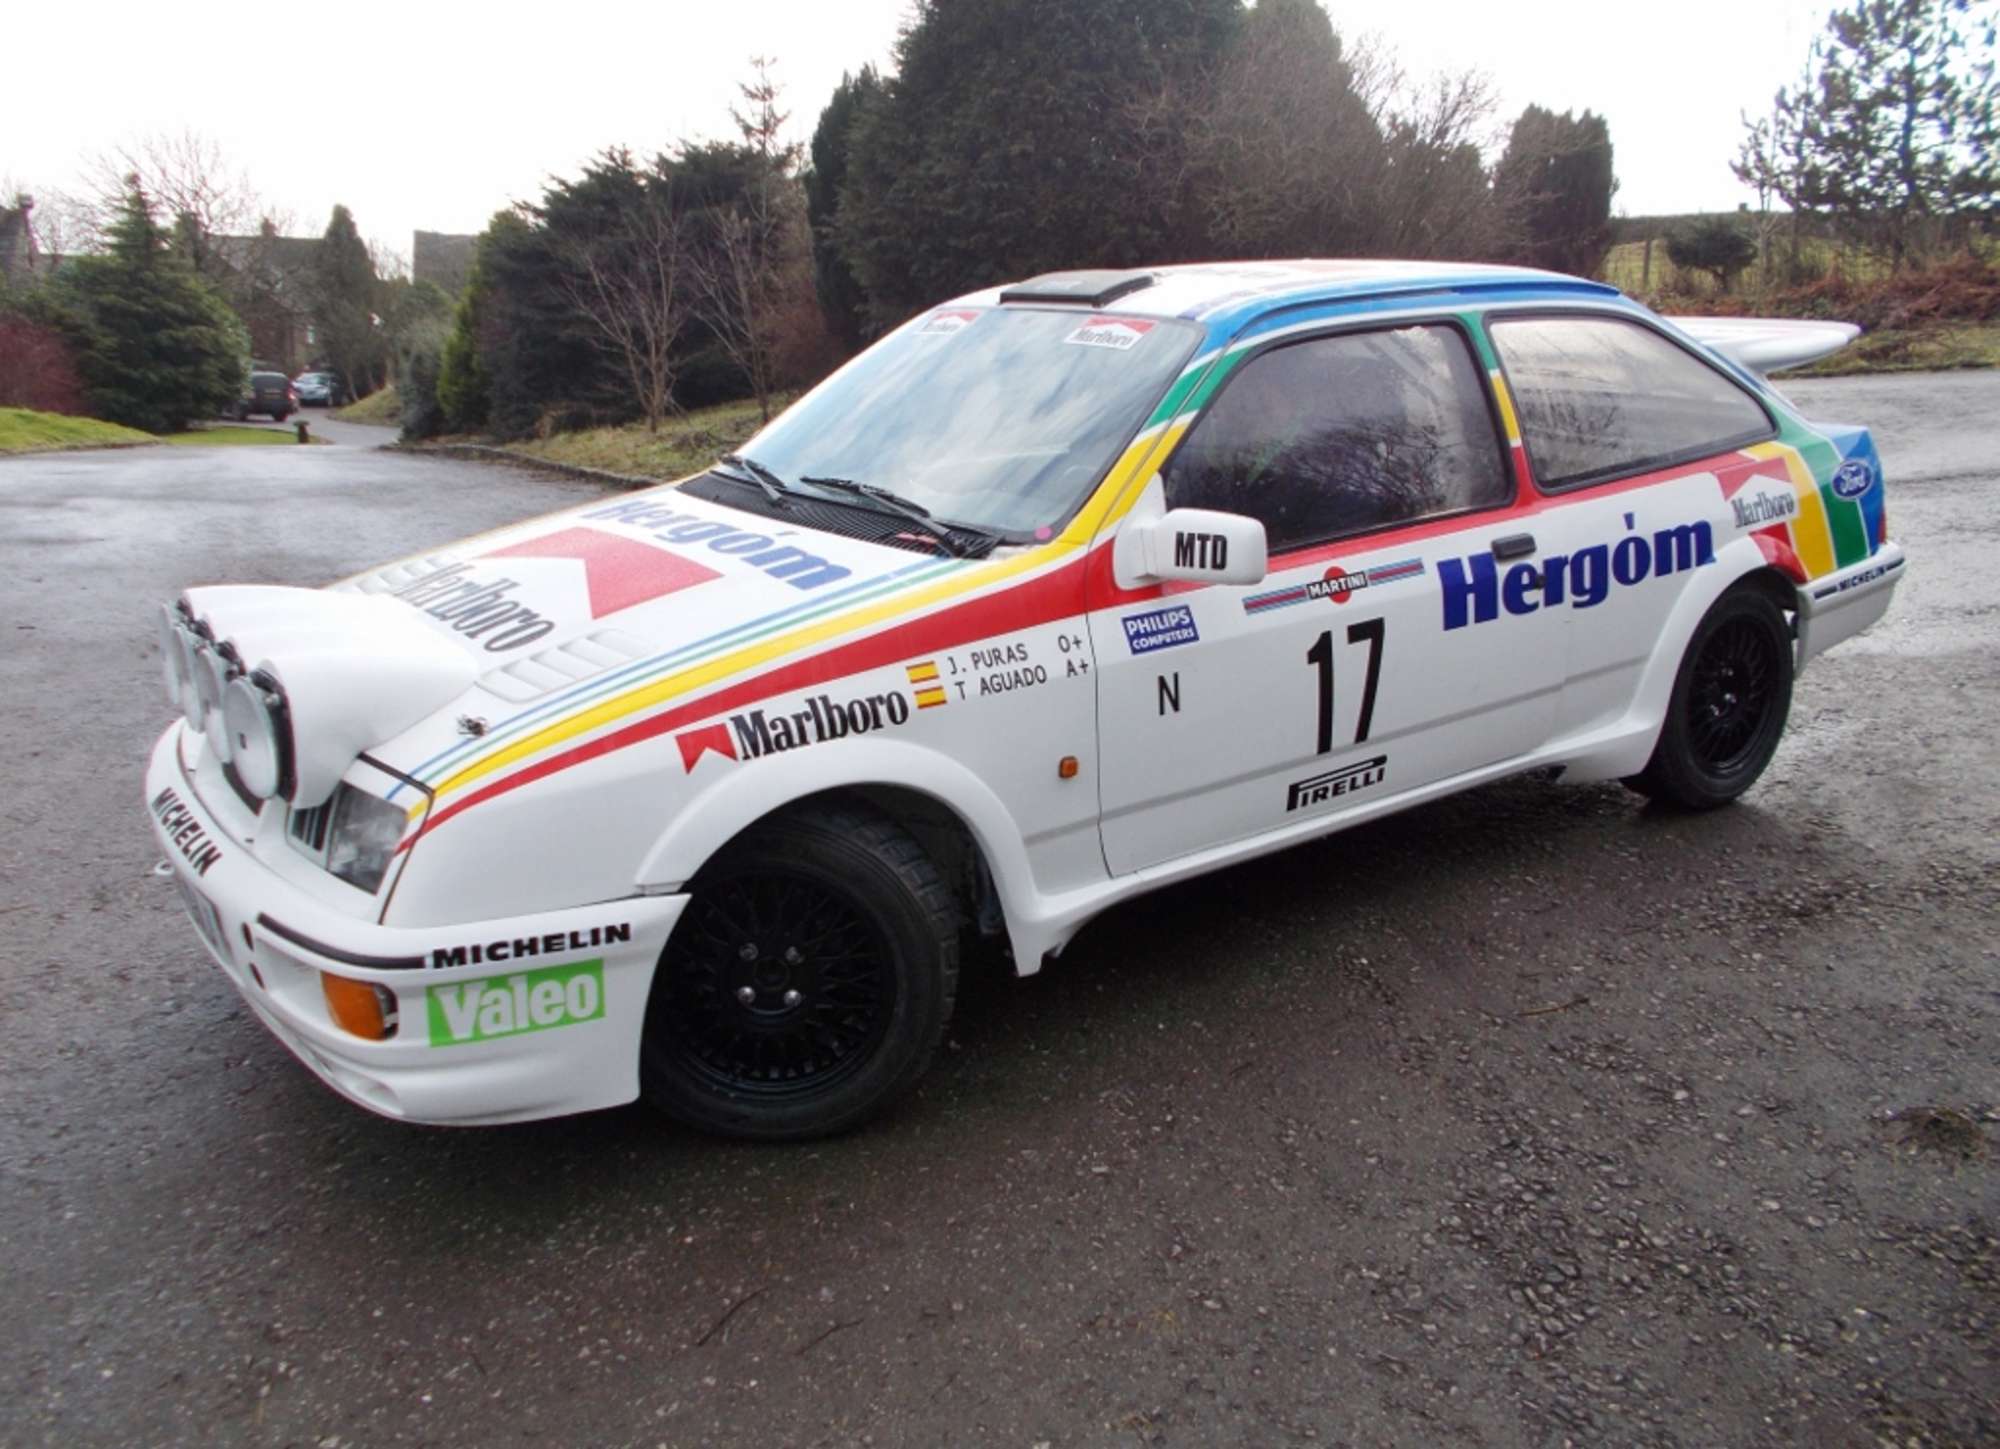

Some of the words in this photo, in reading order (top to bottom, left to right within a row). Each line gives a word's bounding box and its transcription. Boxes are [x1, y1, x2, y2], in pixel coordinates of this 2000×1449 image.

[1840, 464, 1868, 494] Ford
[1732, 492, 1795, 528] Marlboro
[579, 499, 852, 591] Hergóm
[1174, 531, 1228, 571] MTD
[1308, 572, 1367, 598] MARTINI
[1437, 512, 1715, 631] Hergóm
[1839, 566, 1886, 592] MICHELIN
[392, 562, 556, 652] Marlboro
[1126, 608, 1190, 636] PHILIPS
[971, 643, 1028, 670] PURAS
[1132, 627, 1195, 650] COMPUTERS
[955, 681, 966, 700] T
[980, 665, 1047, 696] AGUADO
[1066, 659, 1089, 678] A+
[1157, 672, 1181, 716] N
[1307, 616, 1385, 756] 17
[730, 690, 909, 761] Marlboro
[1286, 755, 1387, 811] PIRELLI
[151, 787, 223, 878] MICHELIN
[433, 922, 631, 969] MICHELIN
[432, 972, 600, 1041] Valeo
